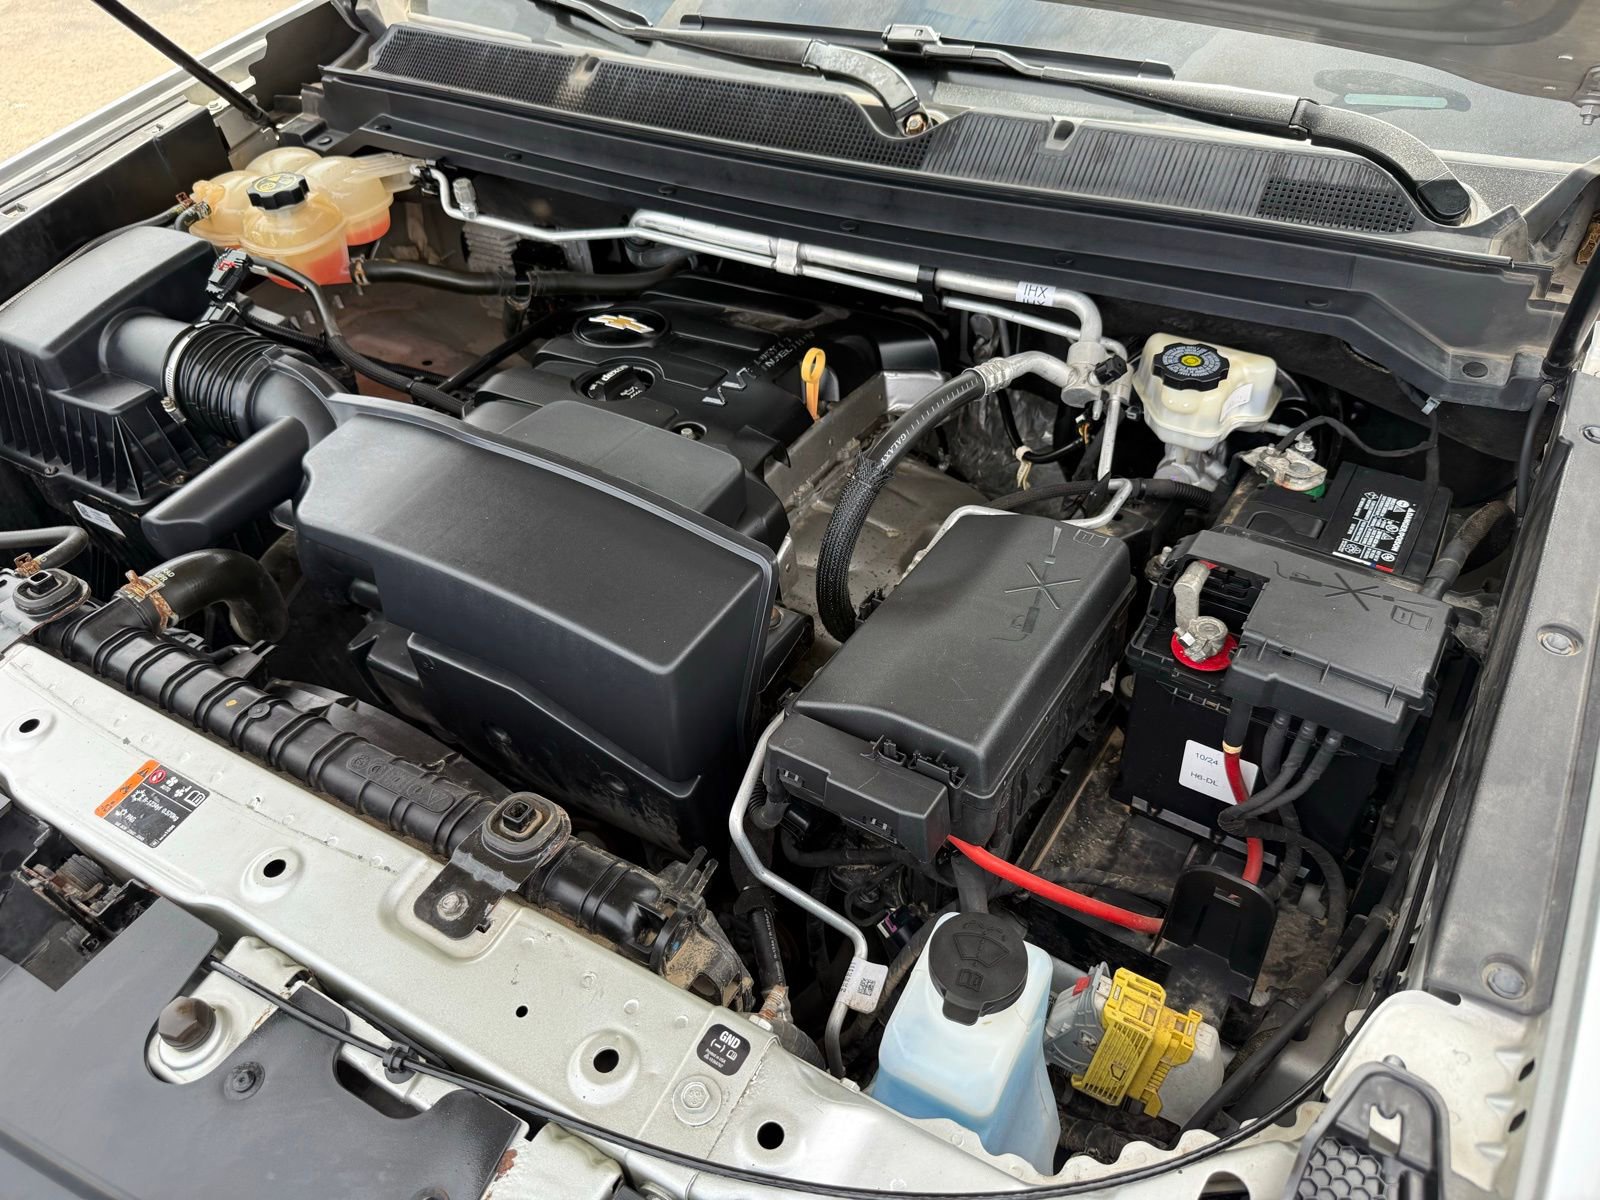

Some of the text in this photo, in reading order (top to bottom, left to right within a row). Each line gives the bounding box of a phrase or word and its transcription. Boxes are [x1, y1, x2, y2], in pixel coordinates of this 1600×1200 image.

[1023, 283, 1049, 299] IHX
[880, 433, 907, 466] GALAXY
[1195, 752, 1219, 766] 10/24
[125, 812, 137, 823] PAG
[719, 1031, 741, 1049] GND
